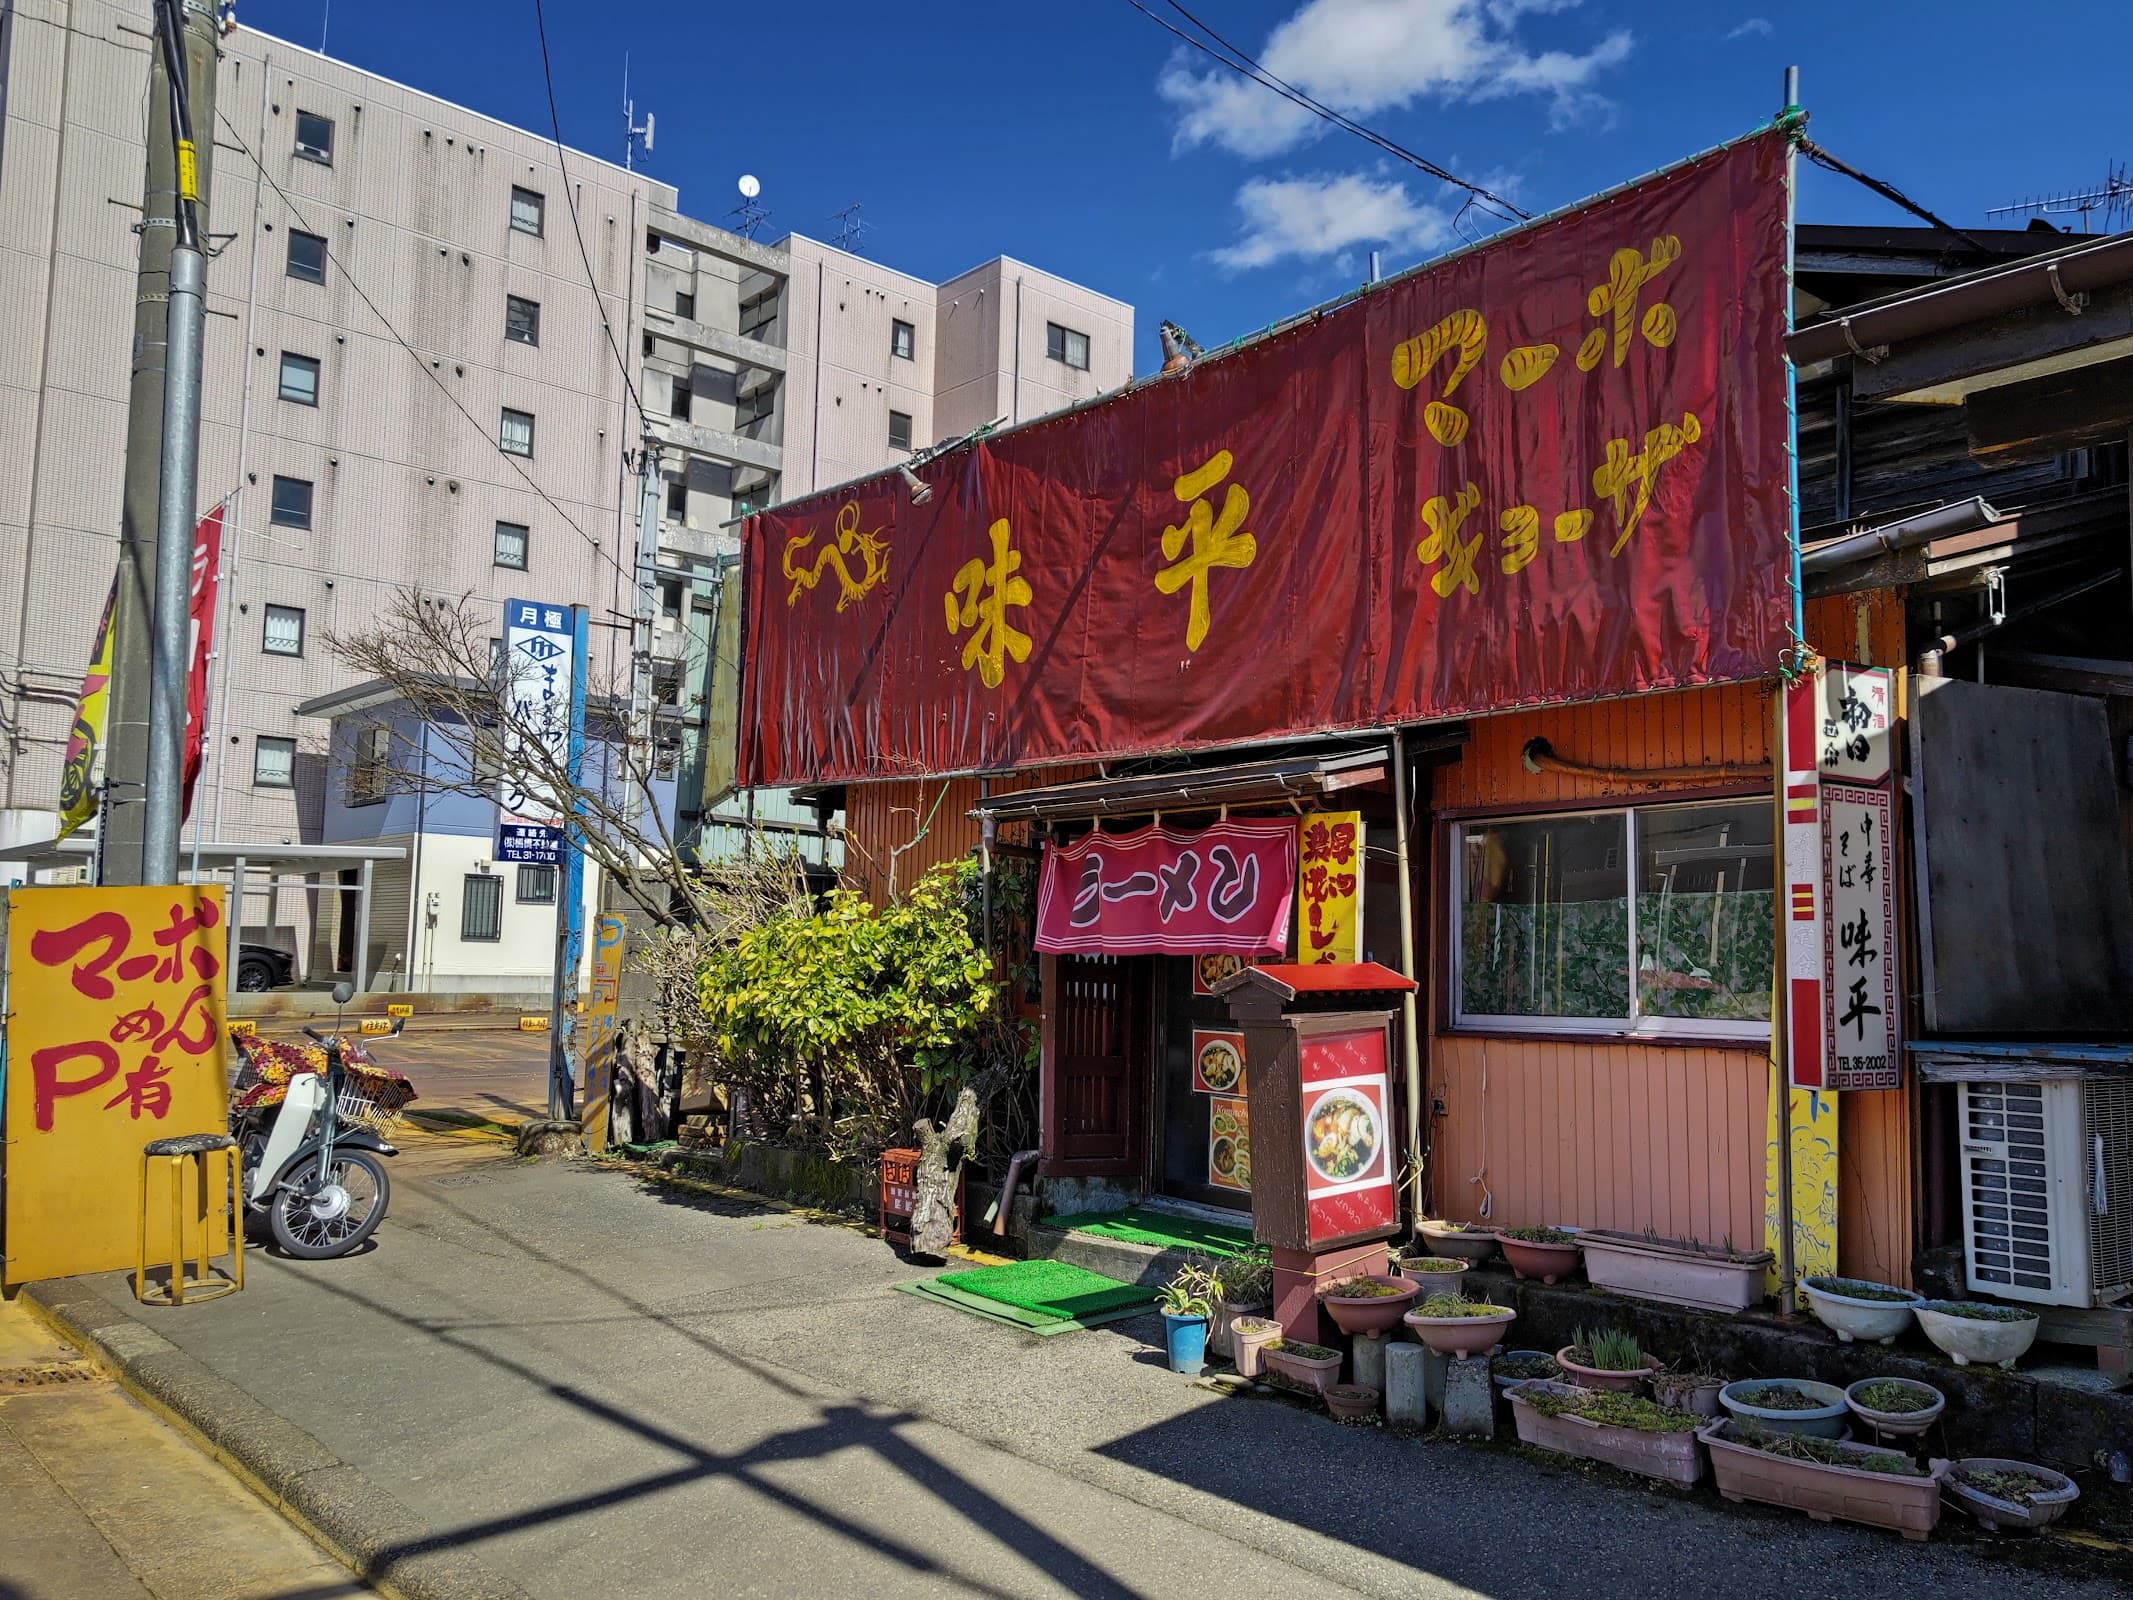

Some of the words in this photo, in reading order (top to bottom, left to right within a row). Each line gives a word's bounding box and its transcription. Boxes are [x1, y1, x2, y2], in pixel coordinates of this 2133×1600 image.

[520, 606, 562, 629] 月極
[507, 850, 522, 859] TEL
[1840, 831, 1857, 888] そば
[1860, 812, 1877, 892] 中華
[1070, 845, 1260, 928] ラーメン
[1839, 908, 1881, 1041] 味平
[1838, 1056, 1852, 1070] TEL
